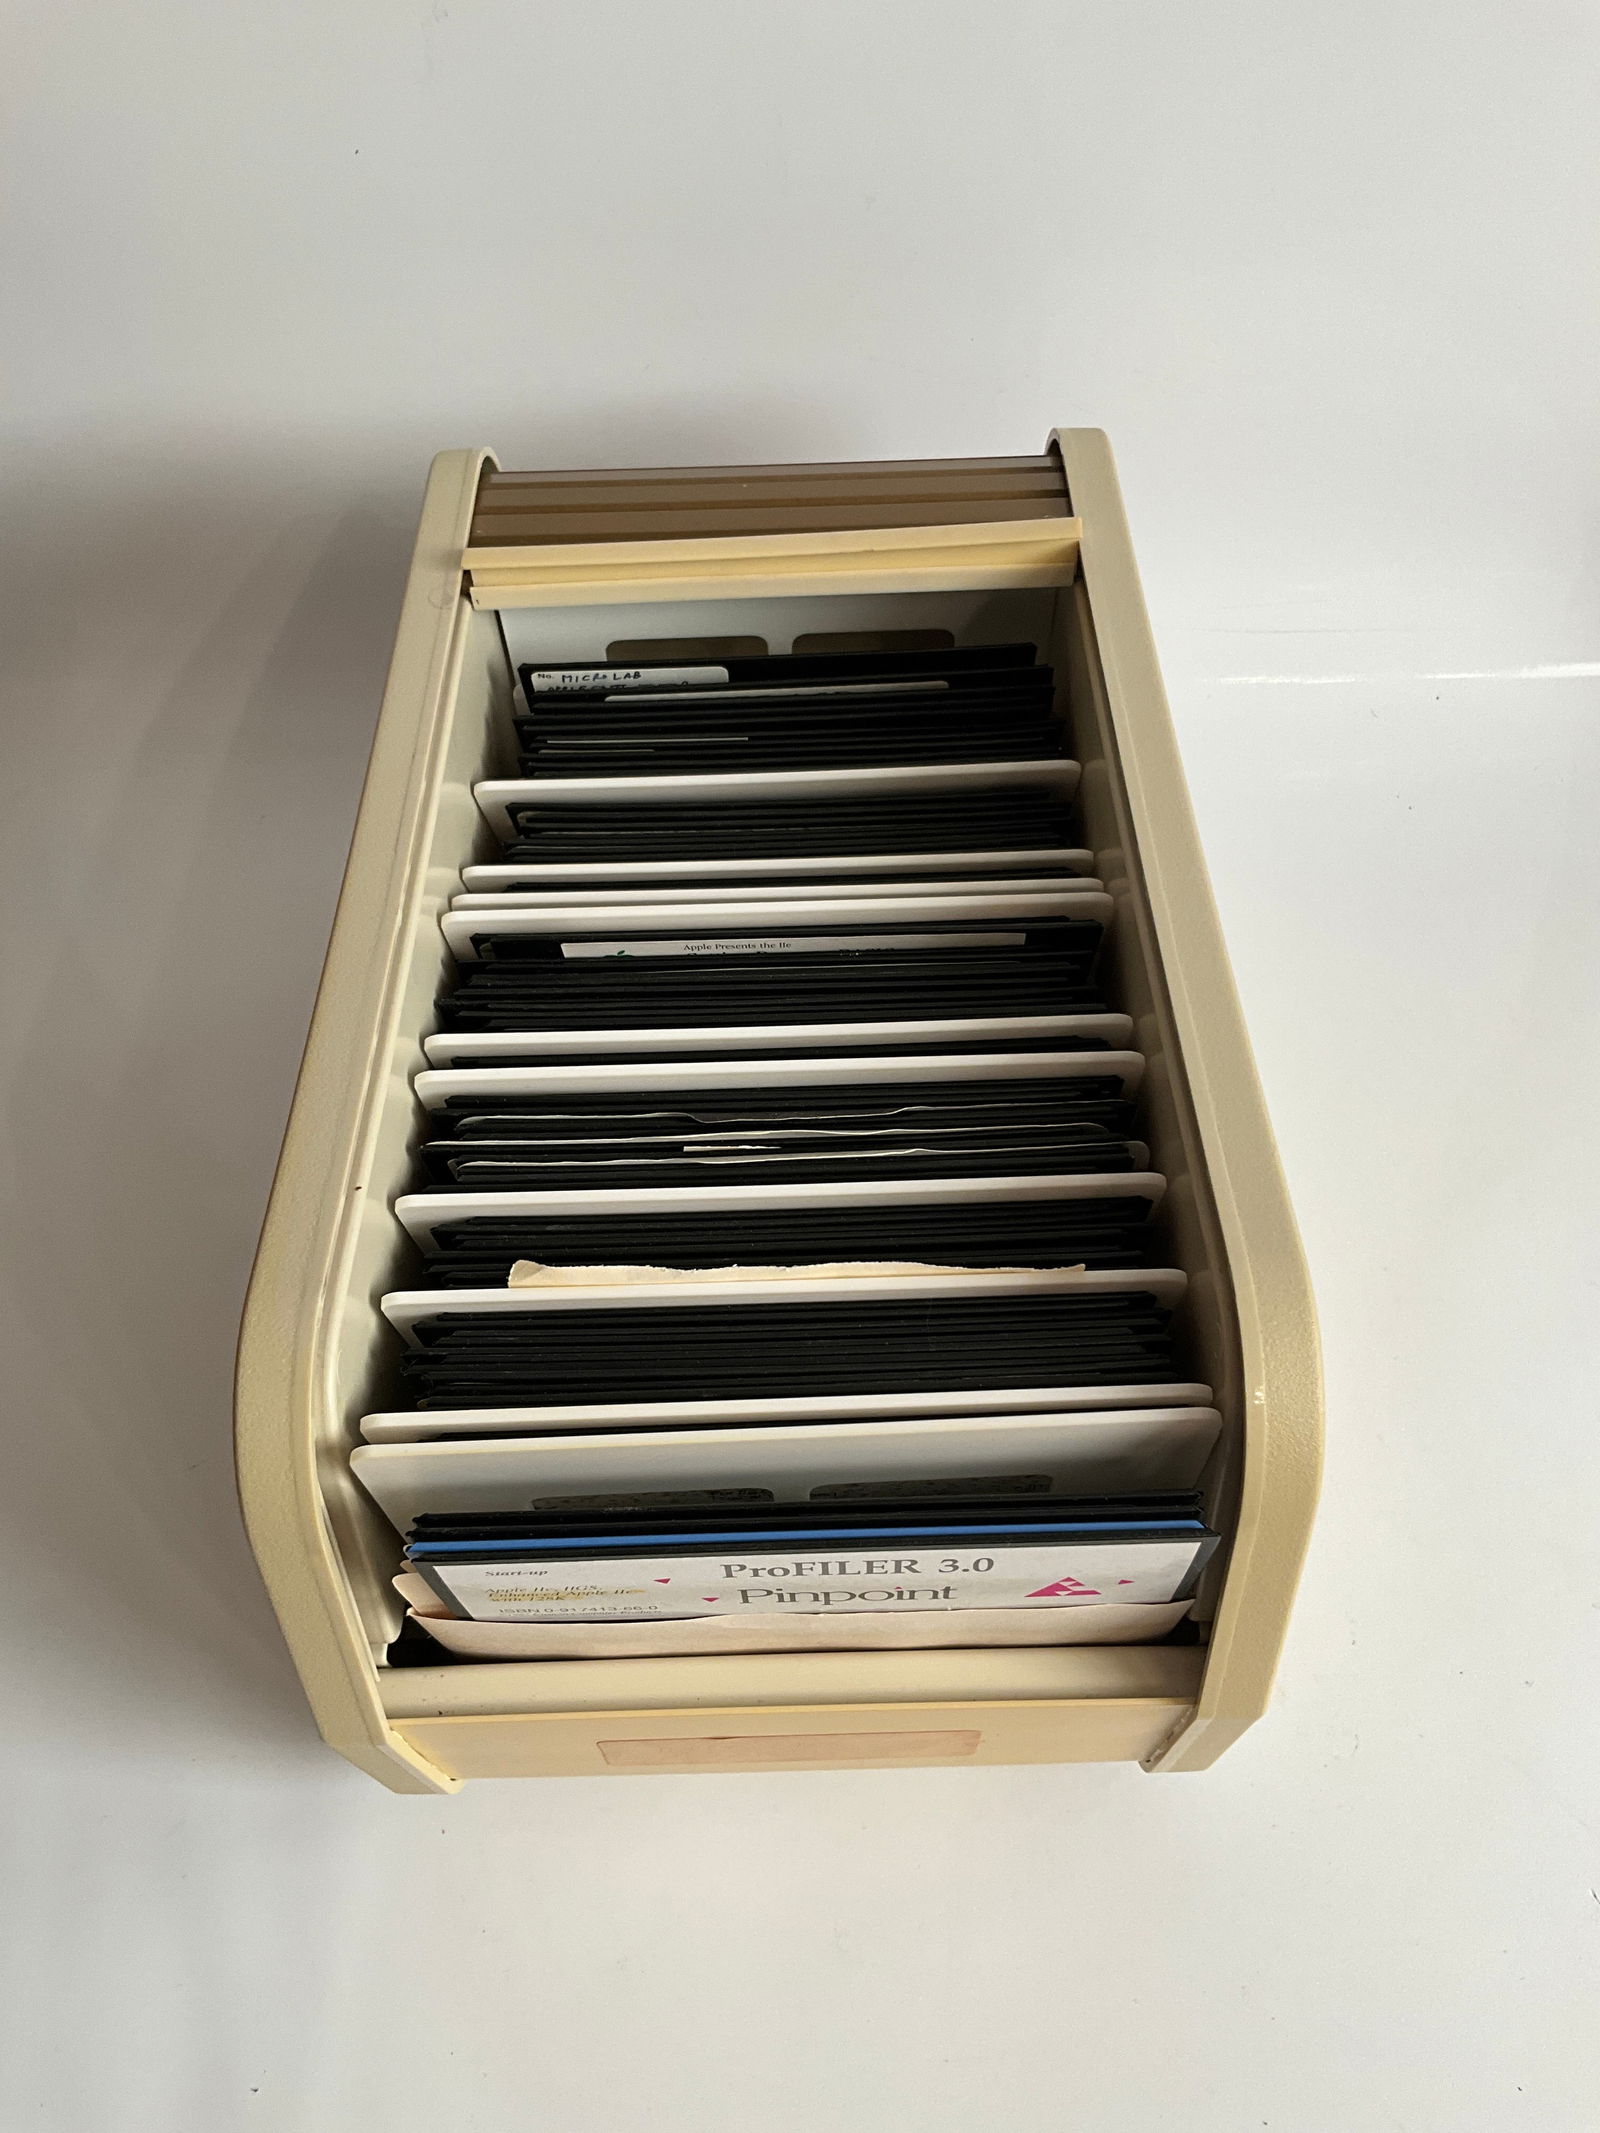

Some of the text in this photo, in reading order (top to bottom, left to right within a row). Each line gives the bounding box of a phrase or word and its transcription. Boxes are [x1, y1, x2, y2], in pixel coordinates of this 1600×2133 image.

[613, 671, 642, 681] LAB
[683, 943, 712, 952] Apple
[715, 942, 757, 950] Presents
[760, 941, 776, 949] the
[720, 1557, 995, 1579] ProFILER 3.0
[737, 1585, 958, 1606] Pinpoint
